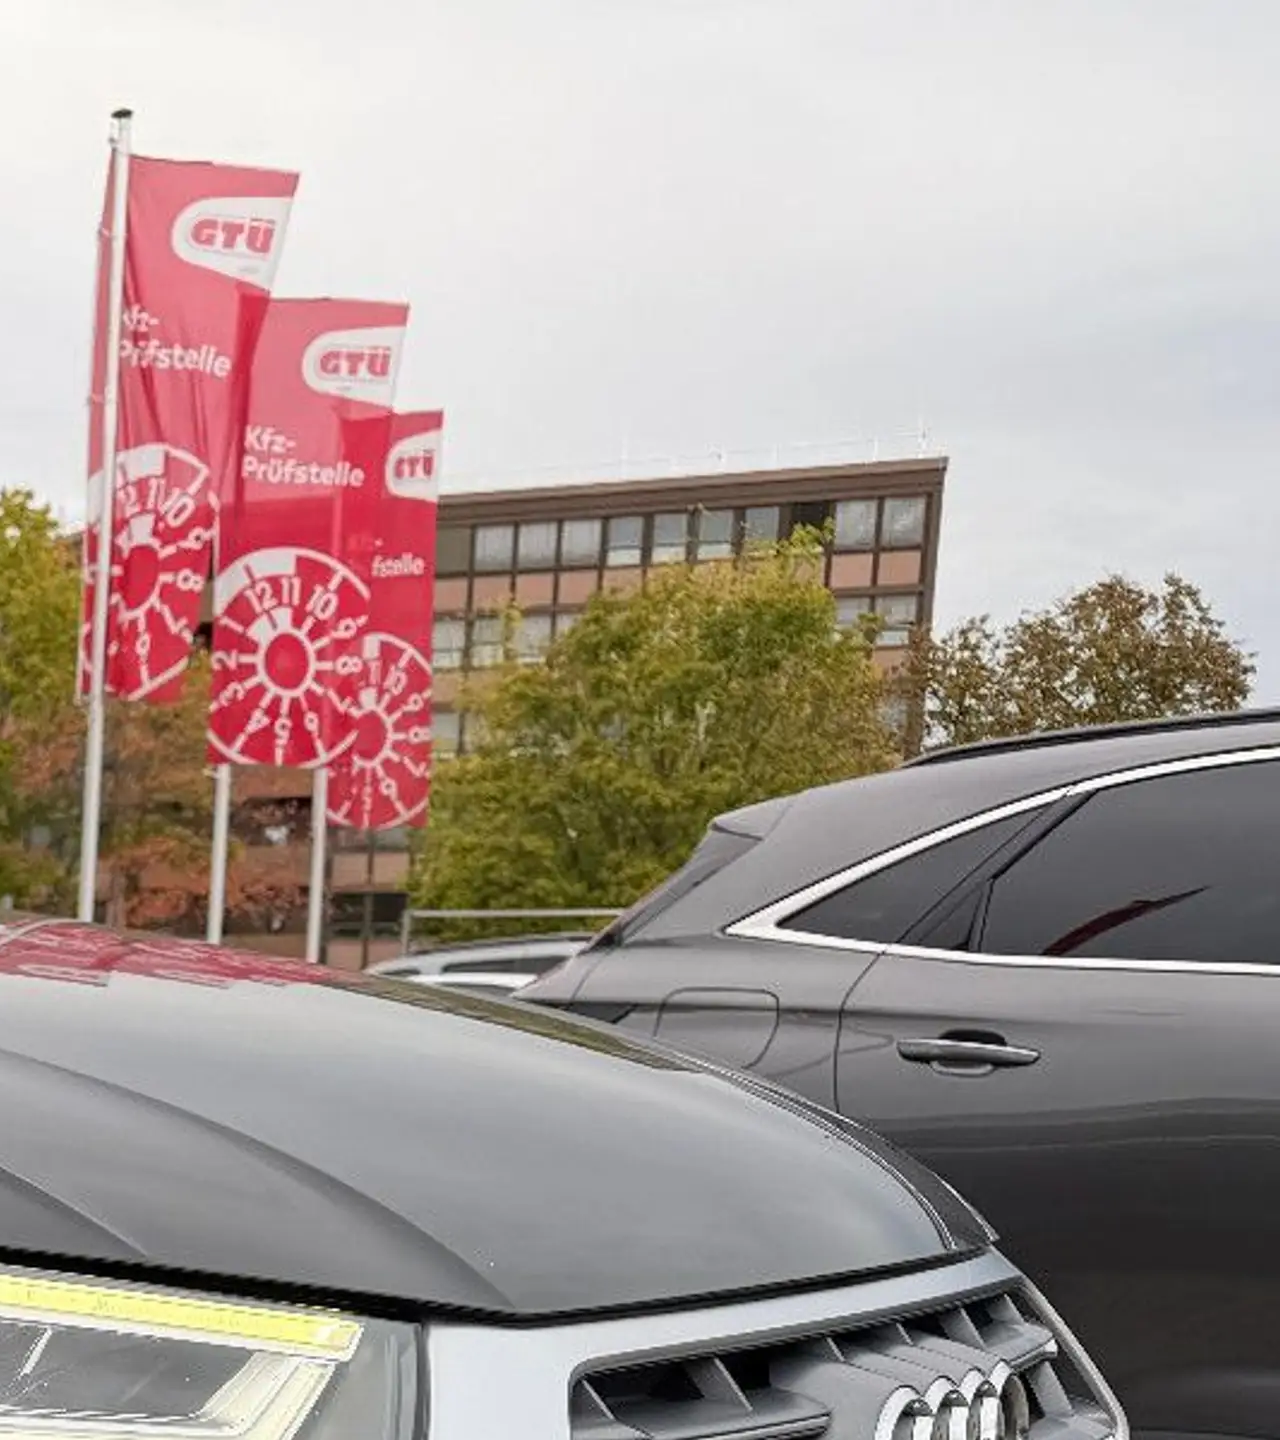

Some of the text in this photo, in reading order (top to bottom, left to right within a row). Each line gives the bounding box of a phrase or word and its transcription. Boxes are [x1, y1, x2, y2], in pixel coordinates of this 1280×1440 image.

[190, 216, 276, 255] GTÜ
[319, 345, 391, 378] GTÜ
[245, 424, 296, 453] Kfz-
[242, 454, 366, 490] Prüfstelle
[244, 579, 278, 614] 12
[280, 576, 302, 607] 11
[306, 583, 339, 621] 10
